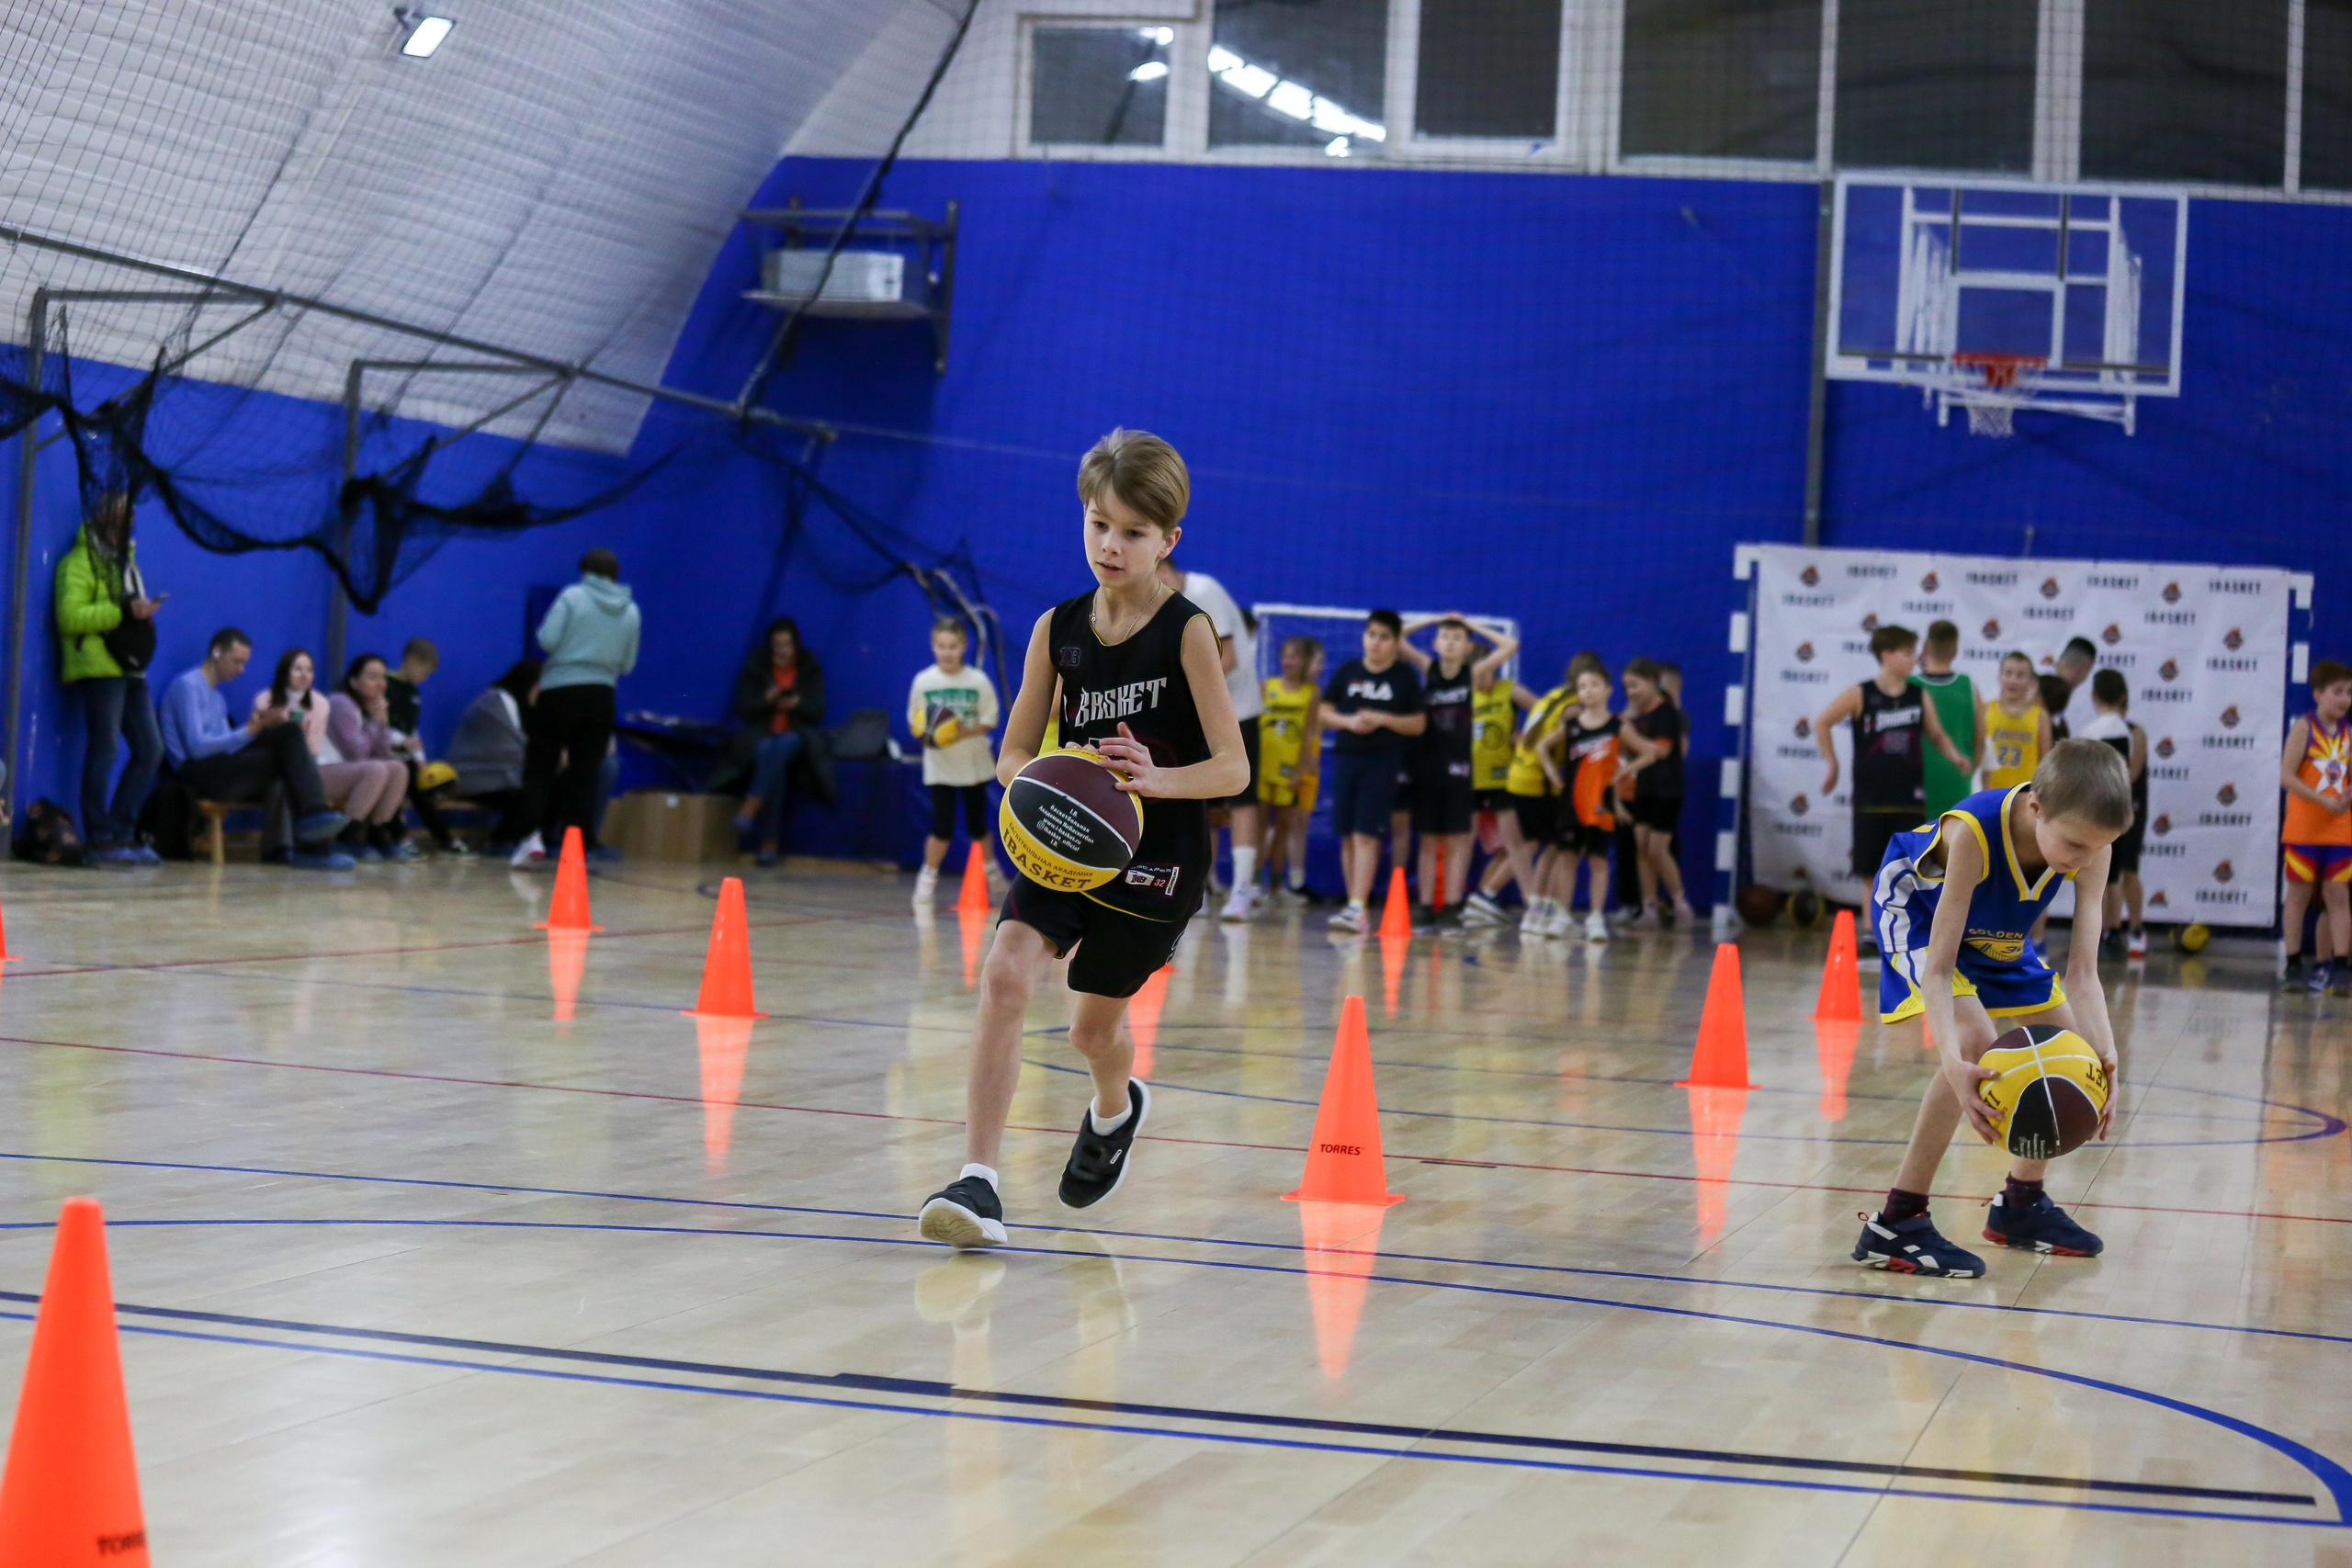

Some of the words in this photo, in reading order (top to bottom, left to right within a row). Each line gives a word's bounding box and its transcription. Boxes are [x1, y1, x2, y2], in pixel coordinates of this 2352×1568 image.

[1348, 680, 1394, 702] FILA
[1074, 677, 1168, 728] BASKET
[1002, 828, 1091, 889] IBASKET
[1054, 865, 1093, 877] АКАДЕМИЯ
[1154, 879, 1166, 887] 32
[1968, 928, 2025, 940] GOLDEN
[1320, 1144, 1361, 1156] TORRES
